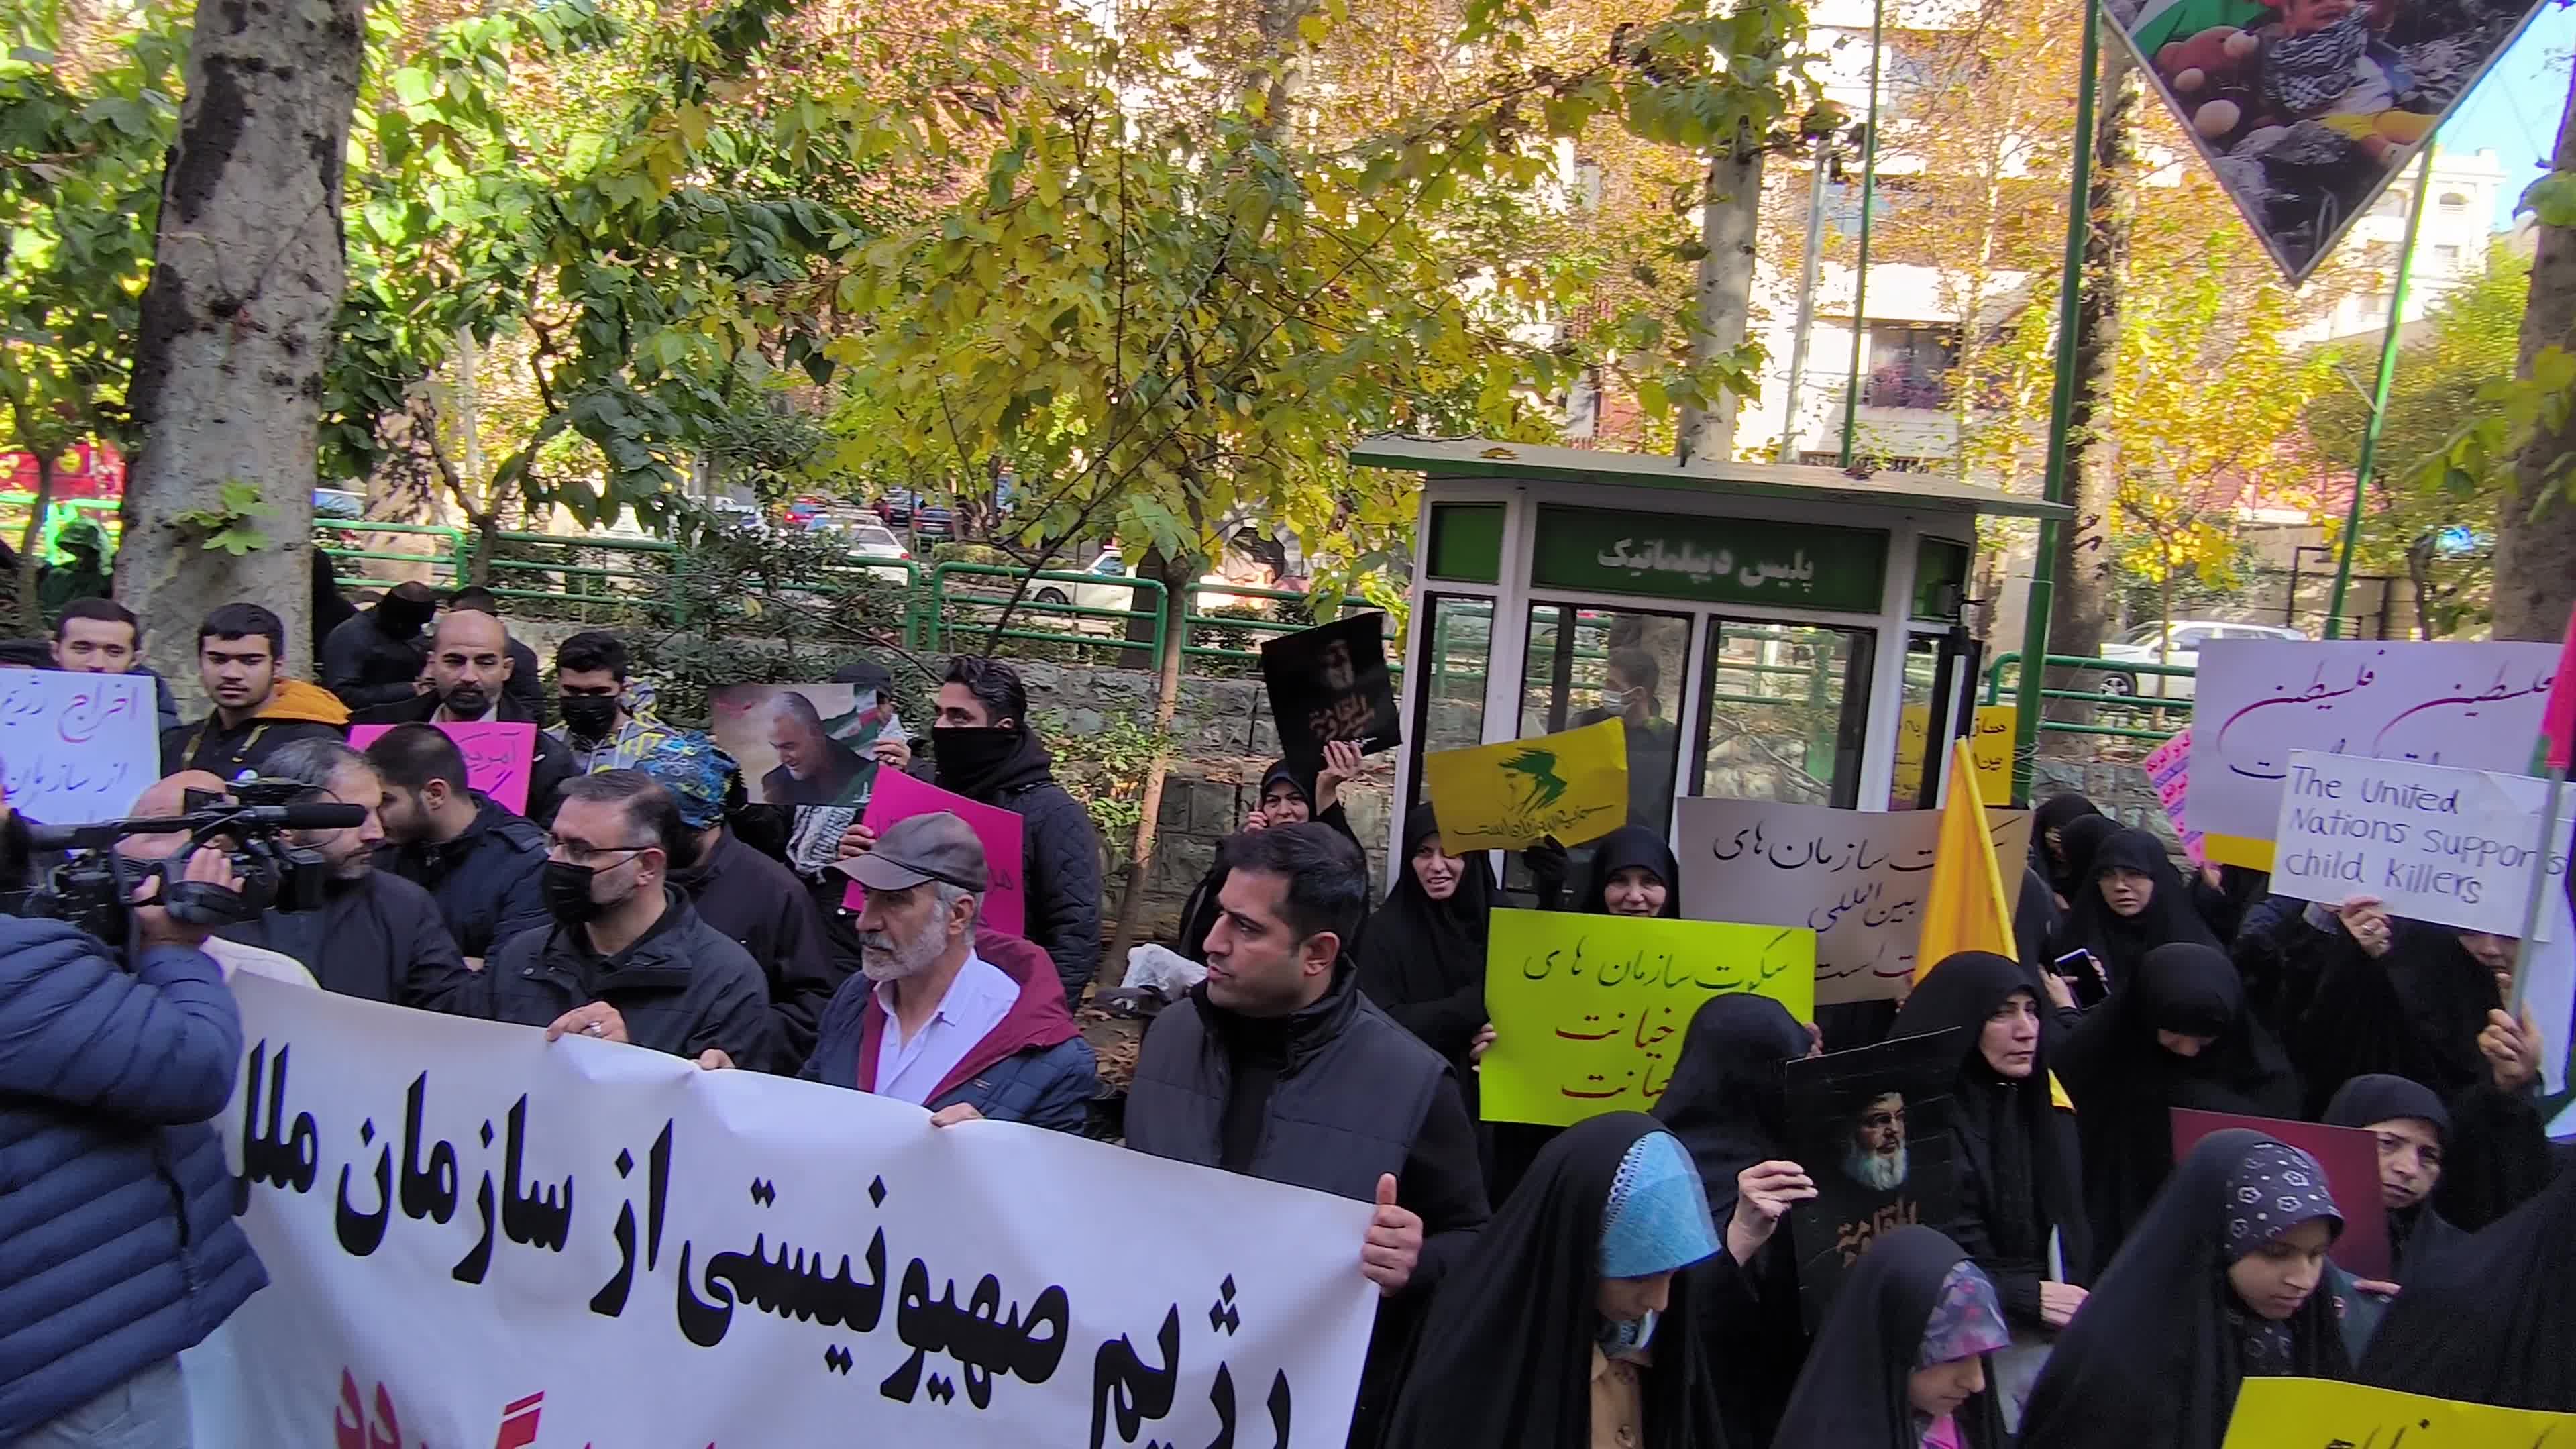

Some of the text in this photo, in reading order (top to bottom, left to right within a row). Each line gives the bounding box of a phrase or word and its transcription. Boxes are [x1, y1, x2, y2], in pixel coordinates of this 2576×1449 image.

[1597, 537, 1814, 593] پلیس دیپلماتیک
[58, 681, 139, 743] اخراج
[2217, 649, 2387, 755] فلسطین
[95, 762, 129, 794] از
[2292, 765, 2461, 815] The United
[1768, 832, 1890, 873] سازمان
[2284, 849, 2365, 885] child
[2286, 806, 2570, 876] Nations suppors
[1597, 948, 1691, 990] سازمان
[1693, 928, 1793, 992] سکوت
[1560, 1061, 1670, 1114] یانت
[231, 1037, 1293, 1449] رژیم صهیونیستی از سازمان ملل
